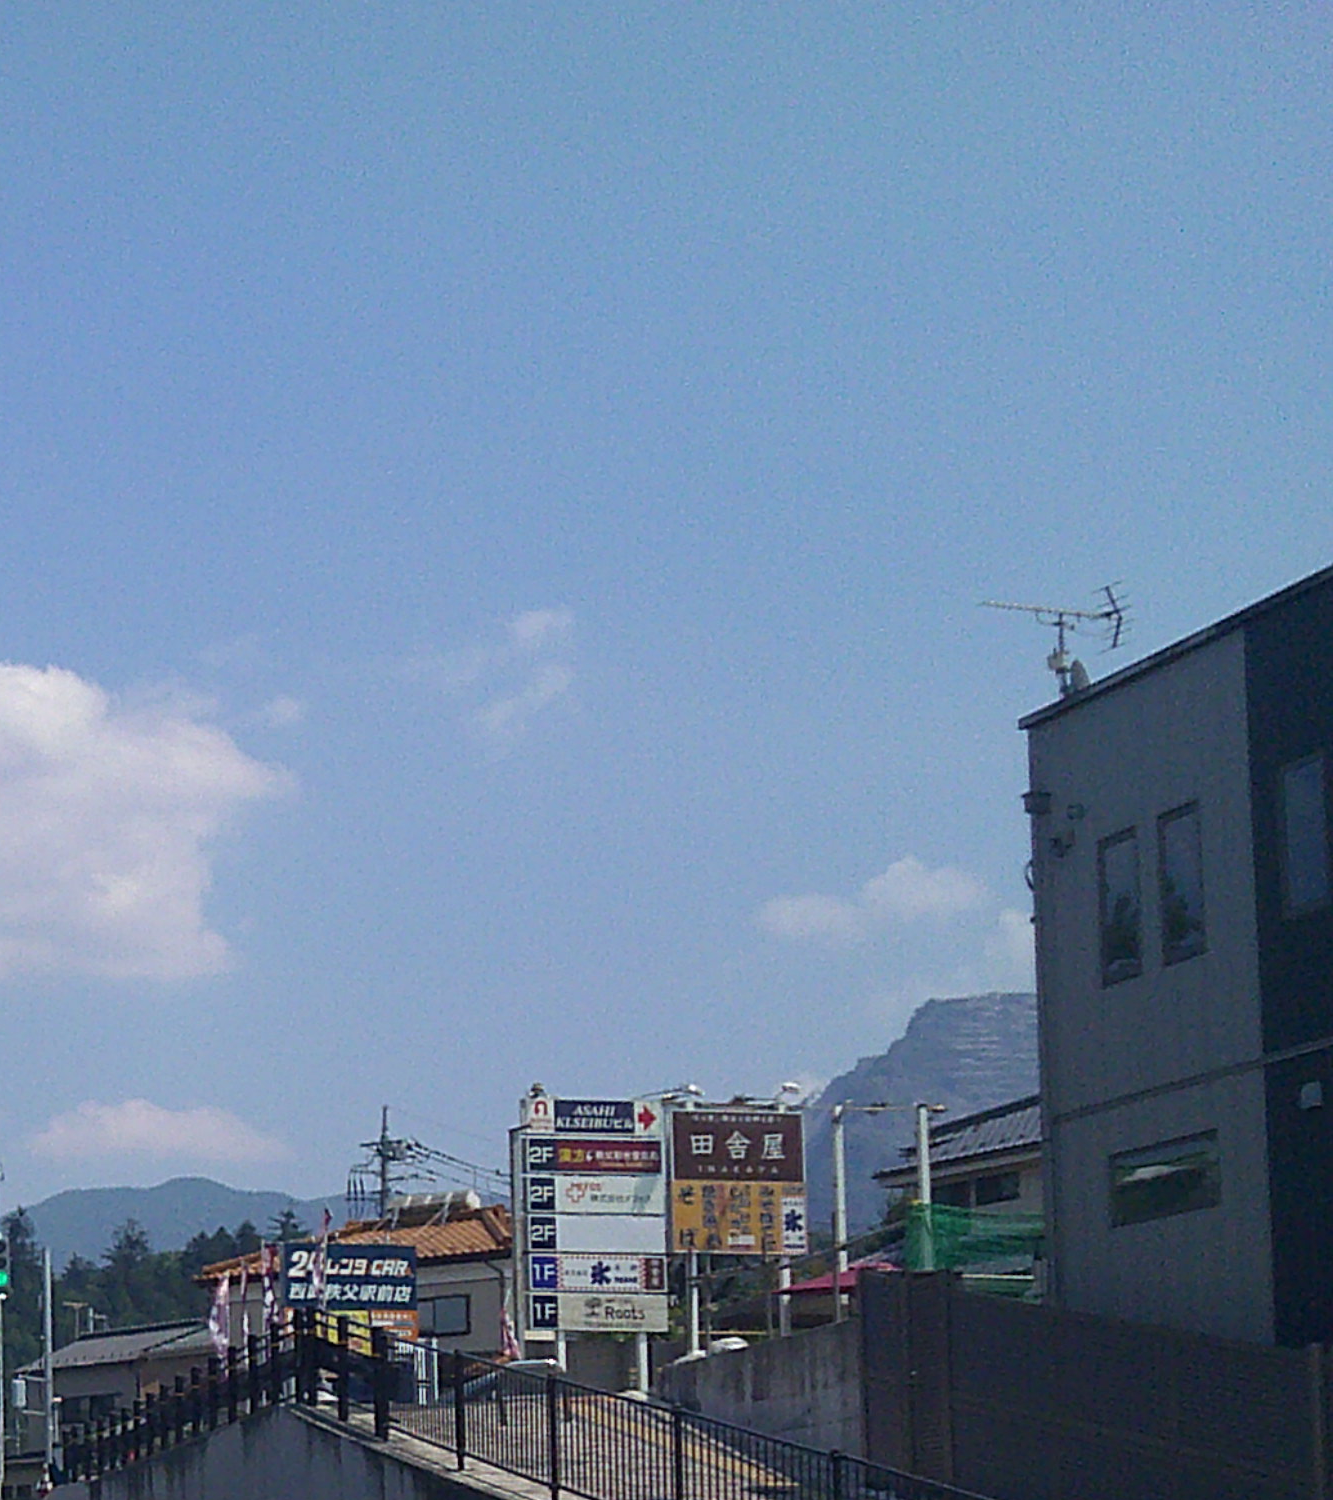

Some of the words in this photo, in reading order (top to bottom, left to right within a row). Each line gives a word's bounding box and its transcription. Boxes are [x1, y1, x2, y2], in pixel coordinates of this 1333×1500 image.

[573, 1104, 616, 1116] ASAHI
[690, 1130, 786, 1159] 田舎屋
[529, 1146, 554, 1163] 2F
[530, 1185, 555, 1202] 2F
[531, 1224, 556, 1242] 2F
[533, 1263, 556, 1281] 1F
[534, 1303, 557, 1320] 1F
[604, 1305, 646, 1321] Roots
